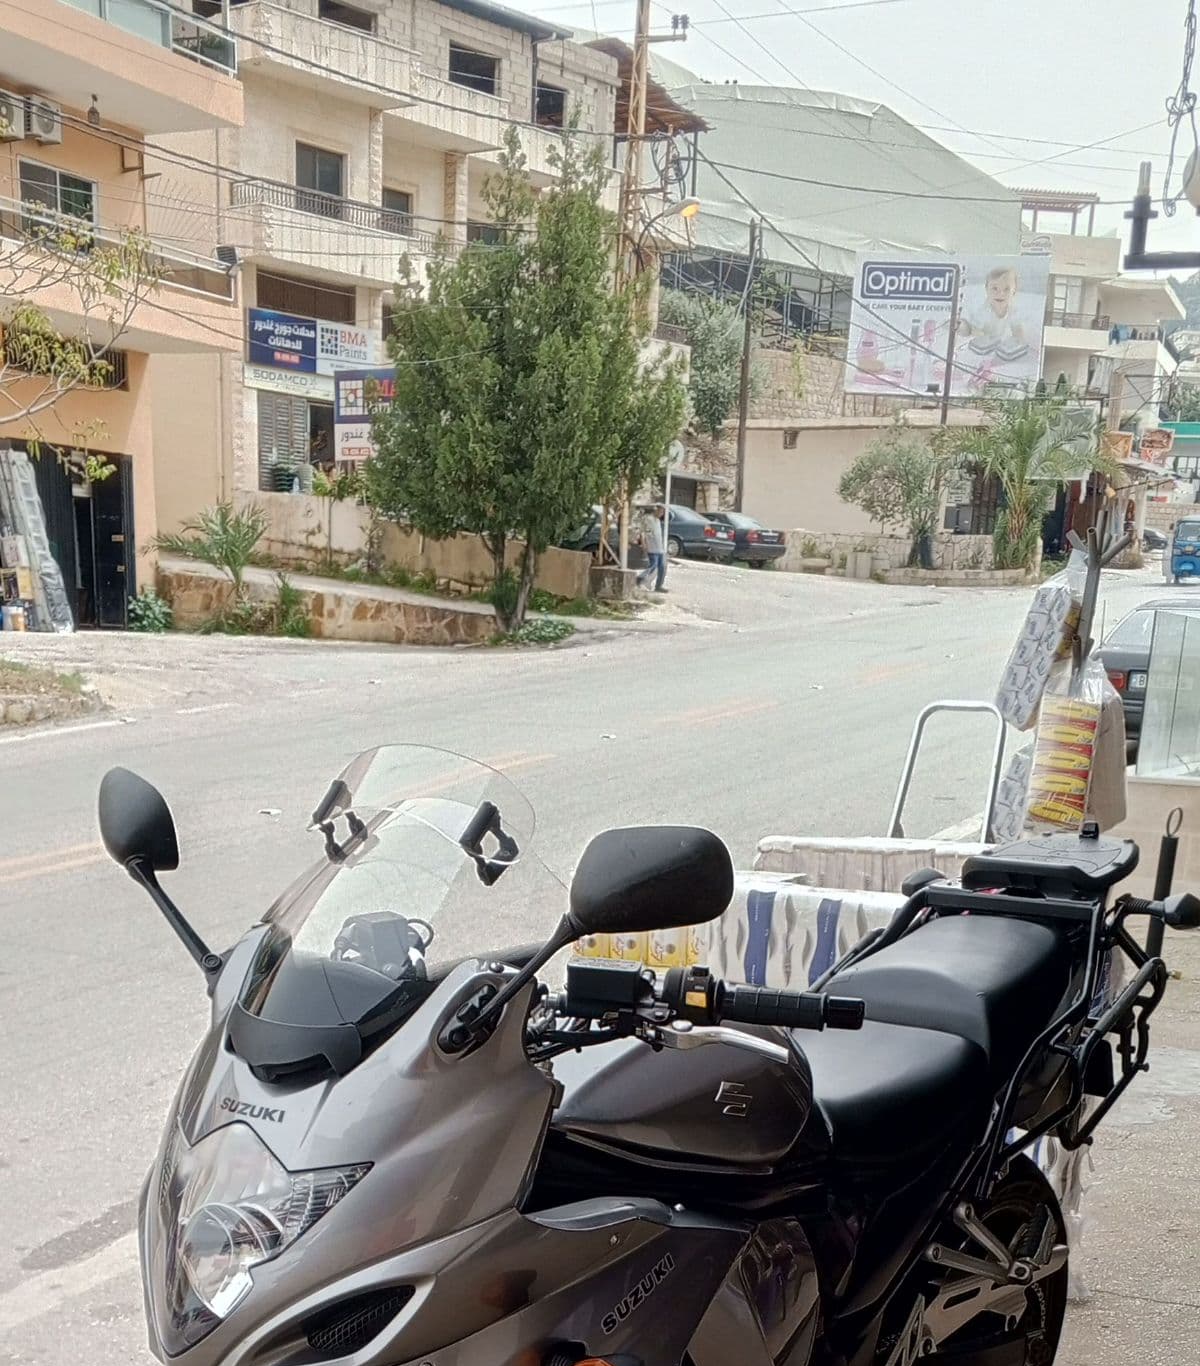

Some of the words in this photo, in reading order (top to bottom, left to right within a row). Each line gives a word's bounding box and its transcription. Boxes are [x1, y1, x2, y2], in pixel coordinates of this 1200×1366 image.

[868, 271, 949, 295] Optimal
[889, 303, 906, 311] YOUR
[907, 303, 924, 311] BABY
[340, 330, 368, 347] BMA
[339, 345, 368, 361] Paints
[252, 368, 308, 386] SODAMCO
[220, 1097, 286, 1122] SUZUKI
[600, 1252, 676, 1335] SUZUKI
